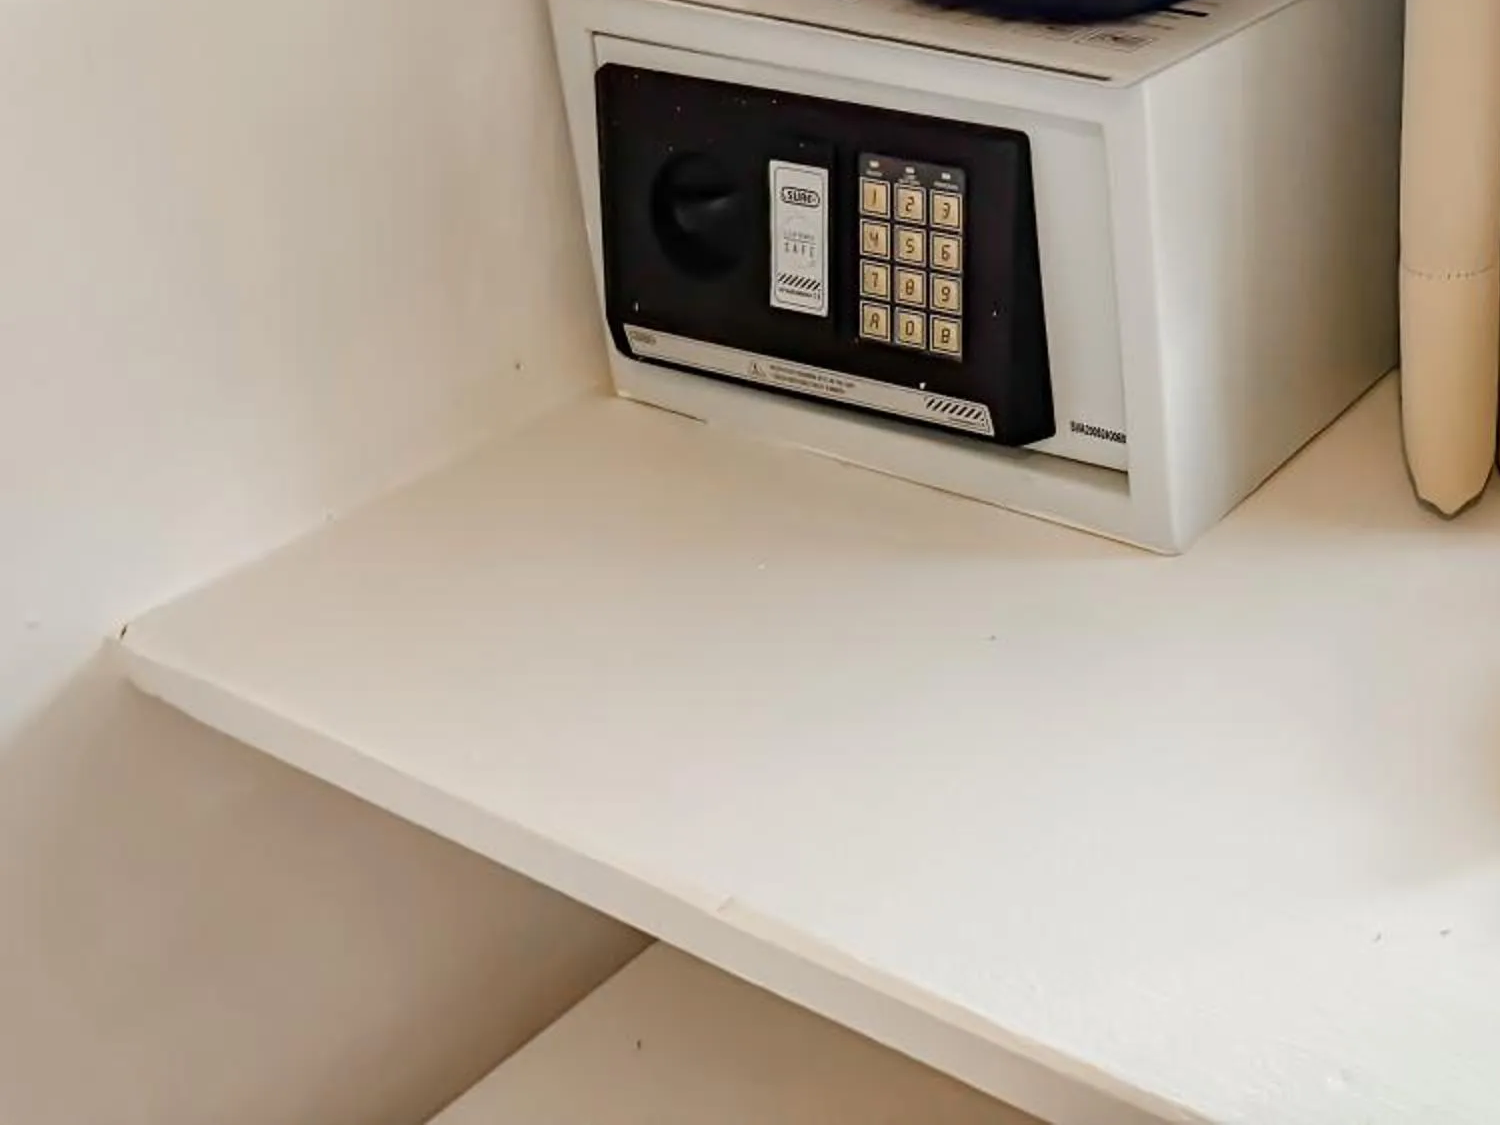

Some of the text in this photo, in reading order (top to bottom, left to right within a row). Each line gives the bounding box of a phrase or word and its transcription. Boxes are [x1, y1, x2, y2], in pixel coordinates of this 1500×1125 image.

[905, 196, 915, 213] 2
[941, 202, 951, 219] 3
[870, 230, 951, 261] 4 5 6
[905, 279, 915, 295] 8
[941, 286, 951, 302] 9
[869, 312, 880, 329] A
[905, 320, 915, 336] 0
